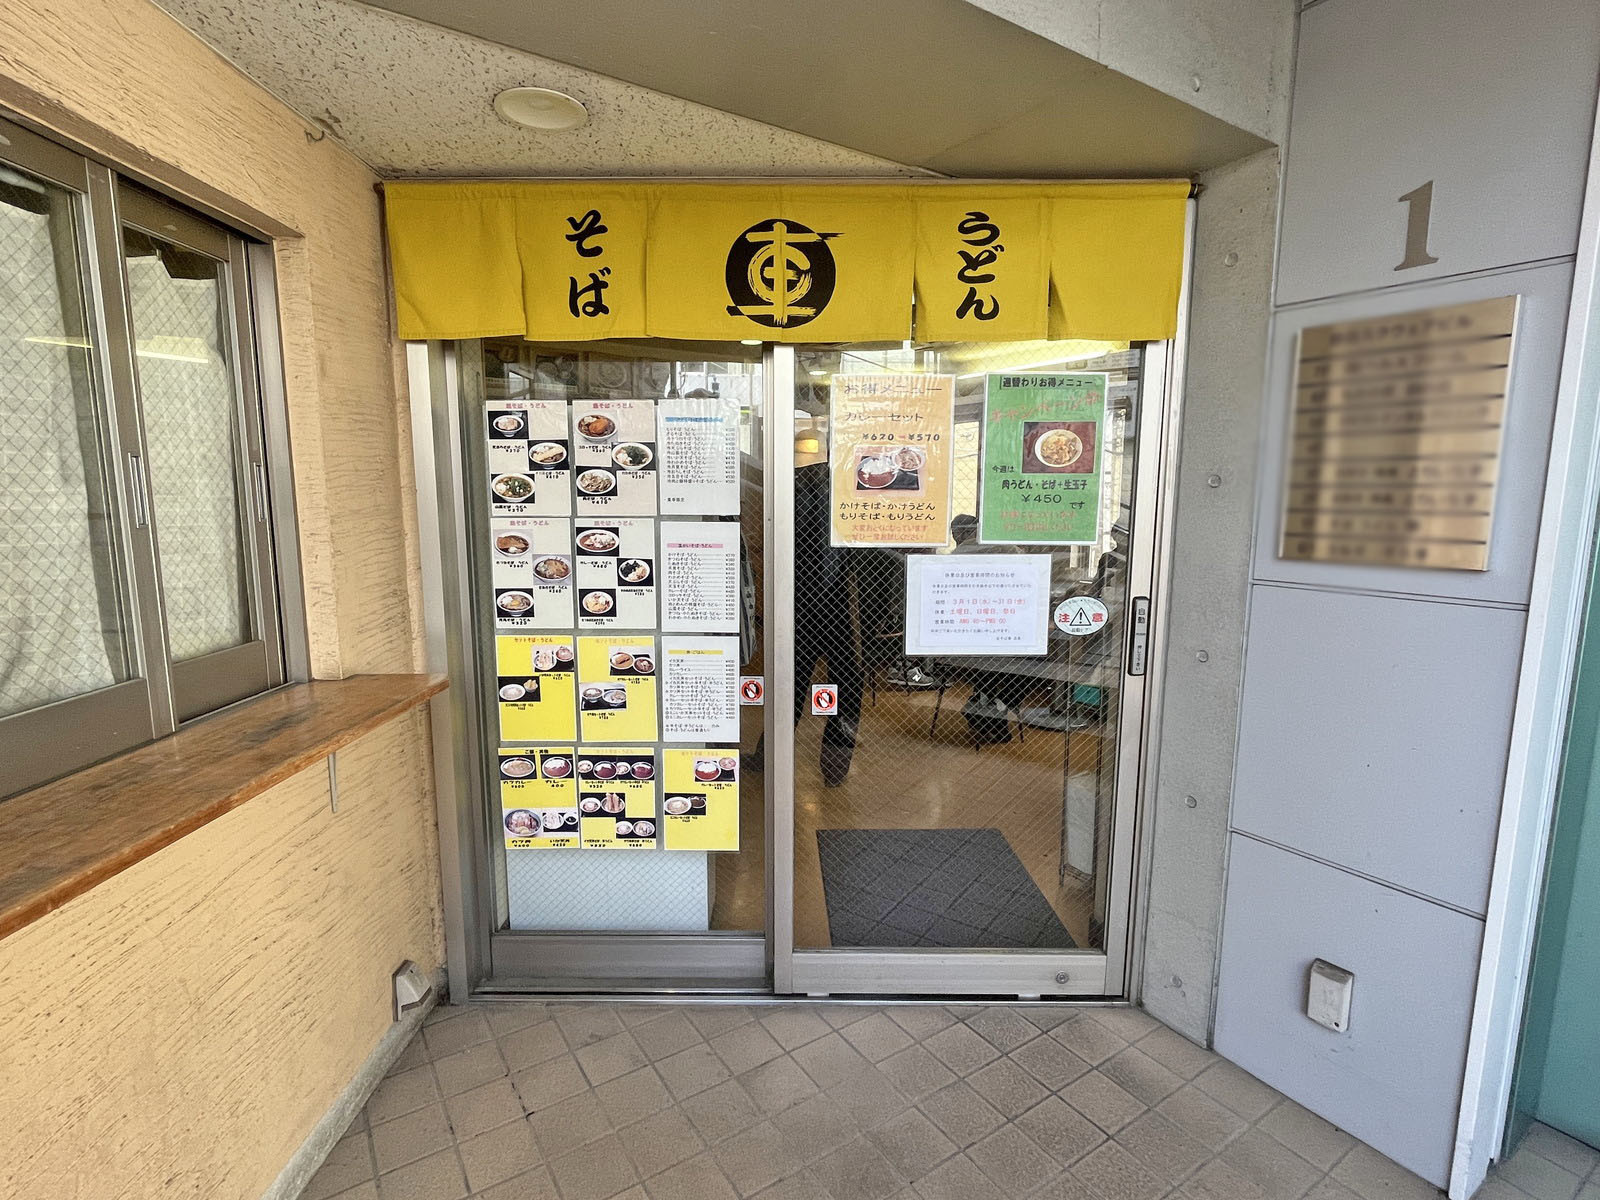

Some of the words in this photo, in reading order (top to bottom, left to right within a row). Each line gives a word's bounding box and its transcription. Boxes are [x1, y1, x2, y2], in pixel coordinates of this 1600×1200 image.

[1393, 180, 1440, 271] 1
[565, 209, 610, 318] そば
[956, 211, 1000, 321] うどん
[844, 383, 943, 395] お得メニュー
[1001, 376, 1094, 388] 週替わりお得メニュー
[839, 502, 936, 511] かけそば・かけうどん
[1021, 494, 1063, 504] ¥450
[1069, 500, 1086, 510] です
[839, 512, 936, 521] もりそば・もりうどん
[1137, 607, 1145, 624] 自動
